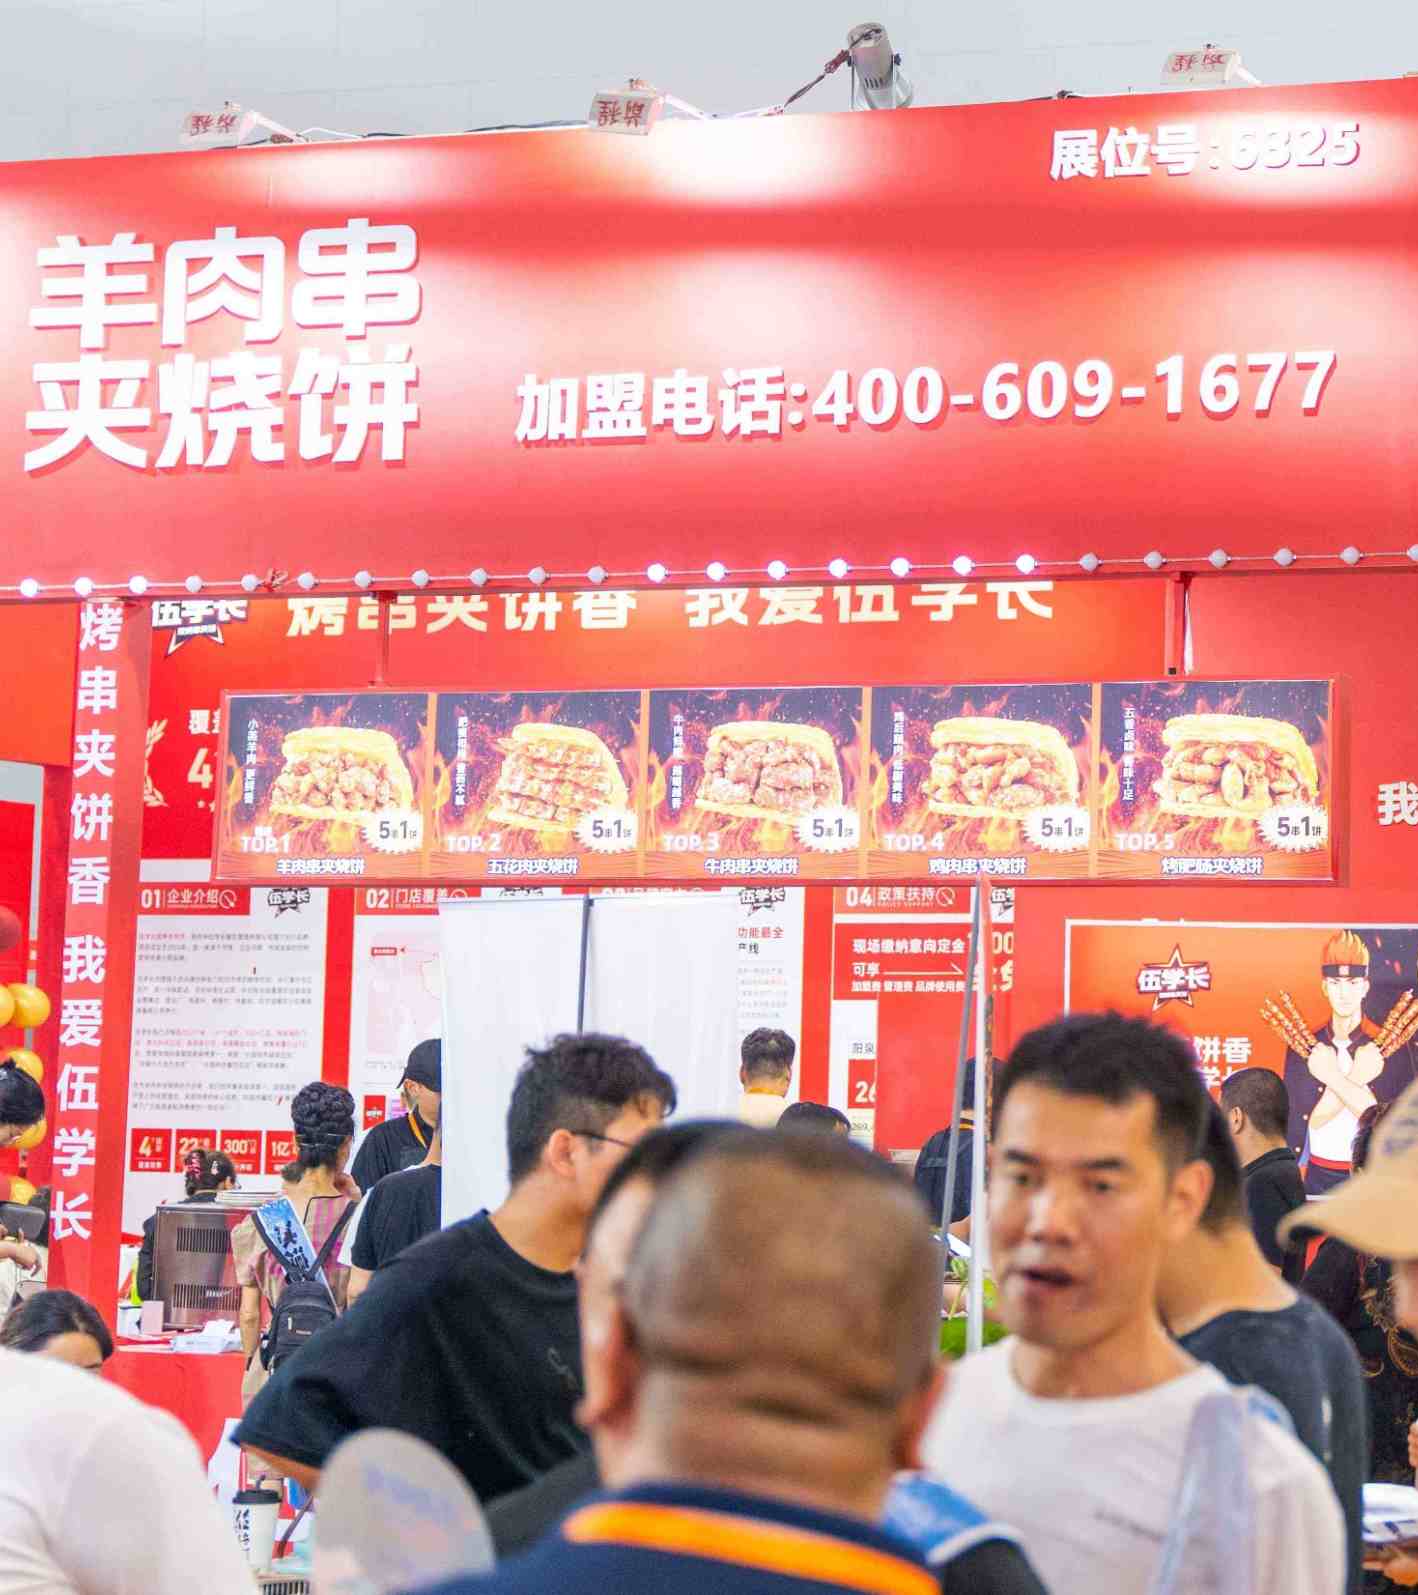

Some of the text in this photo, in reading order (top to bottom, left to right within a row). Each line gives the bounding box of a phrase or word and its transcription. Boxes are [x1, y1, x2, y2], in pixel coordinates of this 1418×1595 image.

[28, 218, 422, 349] 羊肉串
[24, 344, 420, 471] 夹烧饼
[516, 349, 1338, 443] 加盟电话:400-609-1677
[141, 888, 219, 909] 01 企业介绍
[366, 888, 389, 909] 02
[846, 886, 873, 908] 04
[50, 602, 124, 1241] 烤串夹饼香 我爱伍学长
[852, 938, 966, 954] 现场缴纳意向定金
[852, 962, 881, 977] 可享
[1138, 966, 1212, 993] 伍学长
